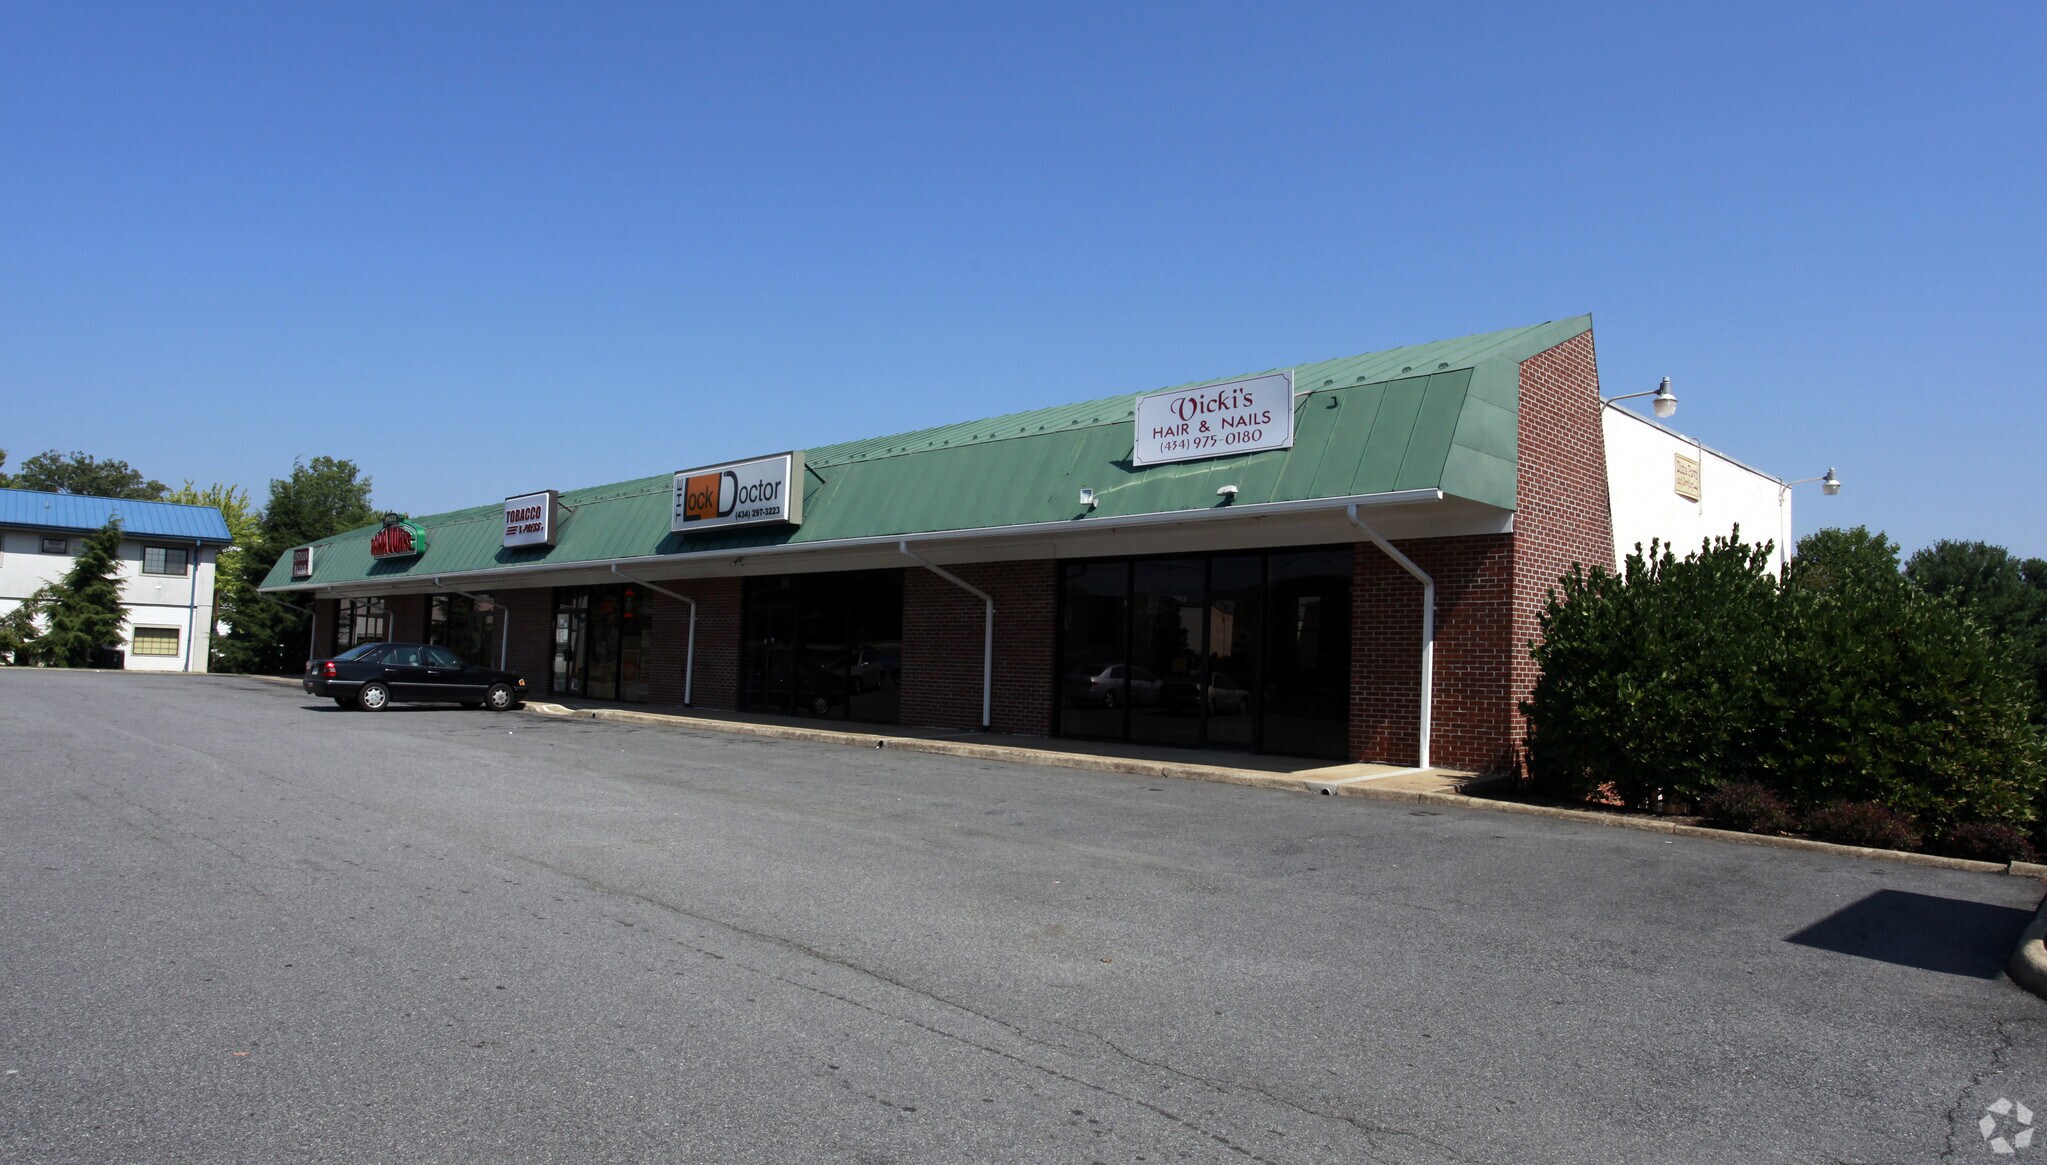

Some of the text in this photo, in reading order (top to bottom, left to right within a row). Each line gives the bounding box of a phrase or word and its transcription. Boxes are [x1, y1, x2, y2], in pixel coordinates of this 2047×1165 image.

[1170, 387, 1253, 422] Vicki's
[1152, 410, 1272, 440] HAIR & NAILS
[1160, 428, 1263, 454] (434) 975-0180
[717, 470, 782, 518] Doctor
[506, 505, 542, 524] TOBACCO
[735, 506, 781, 521] (434) 297-3223
